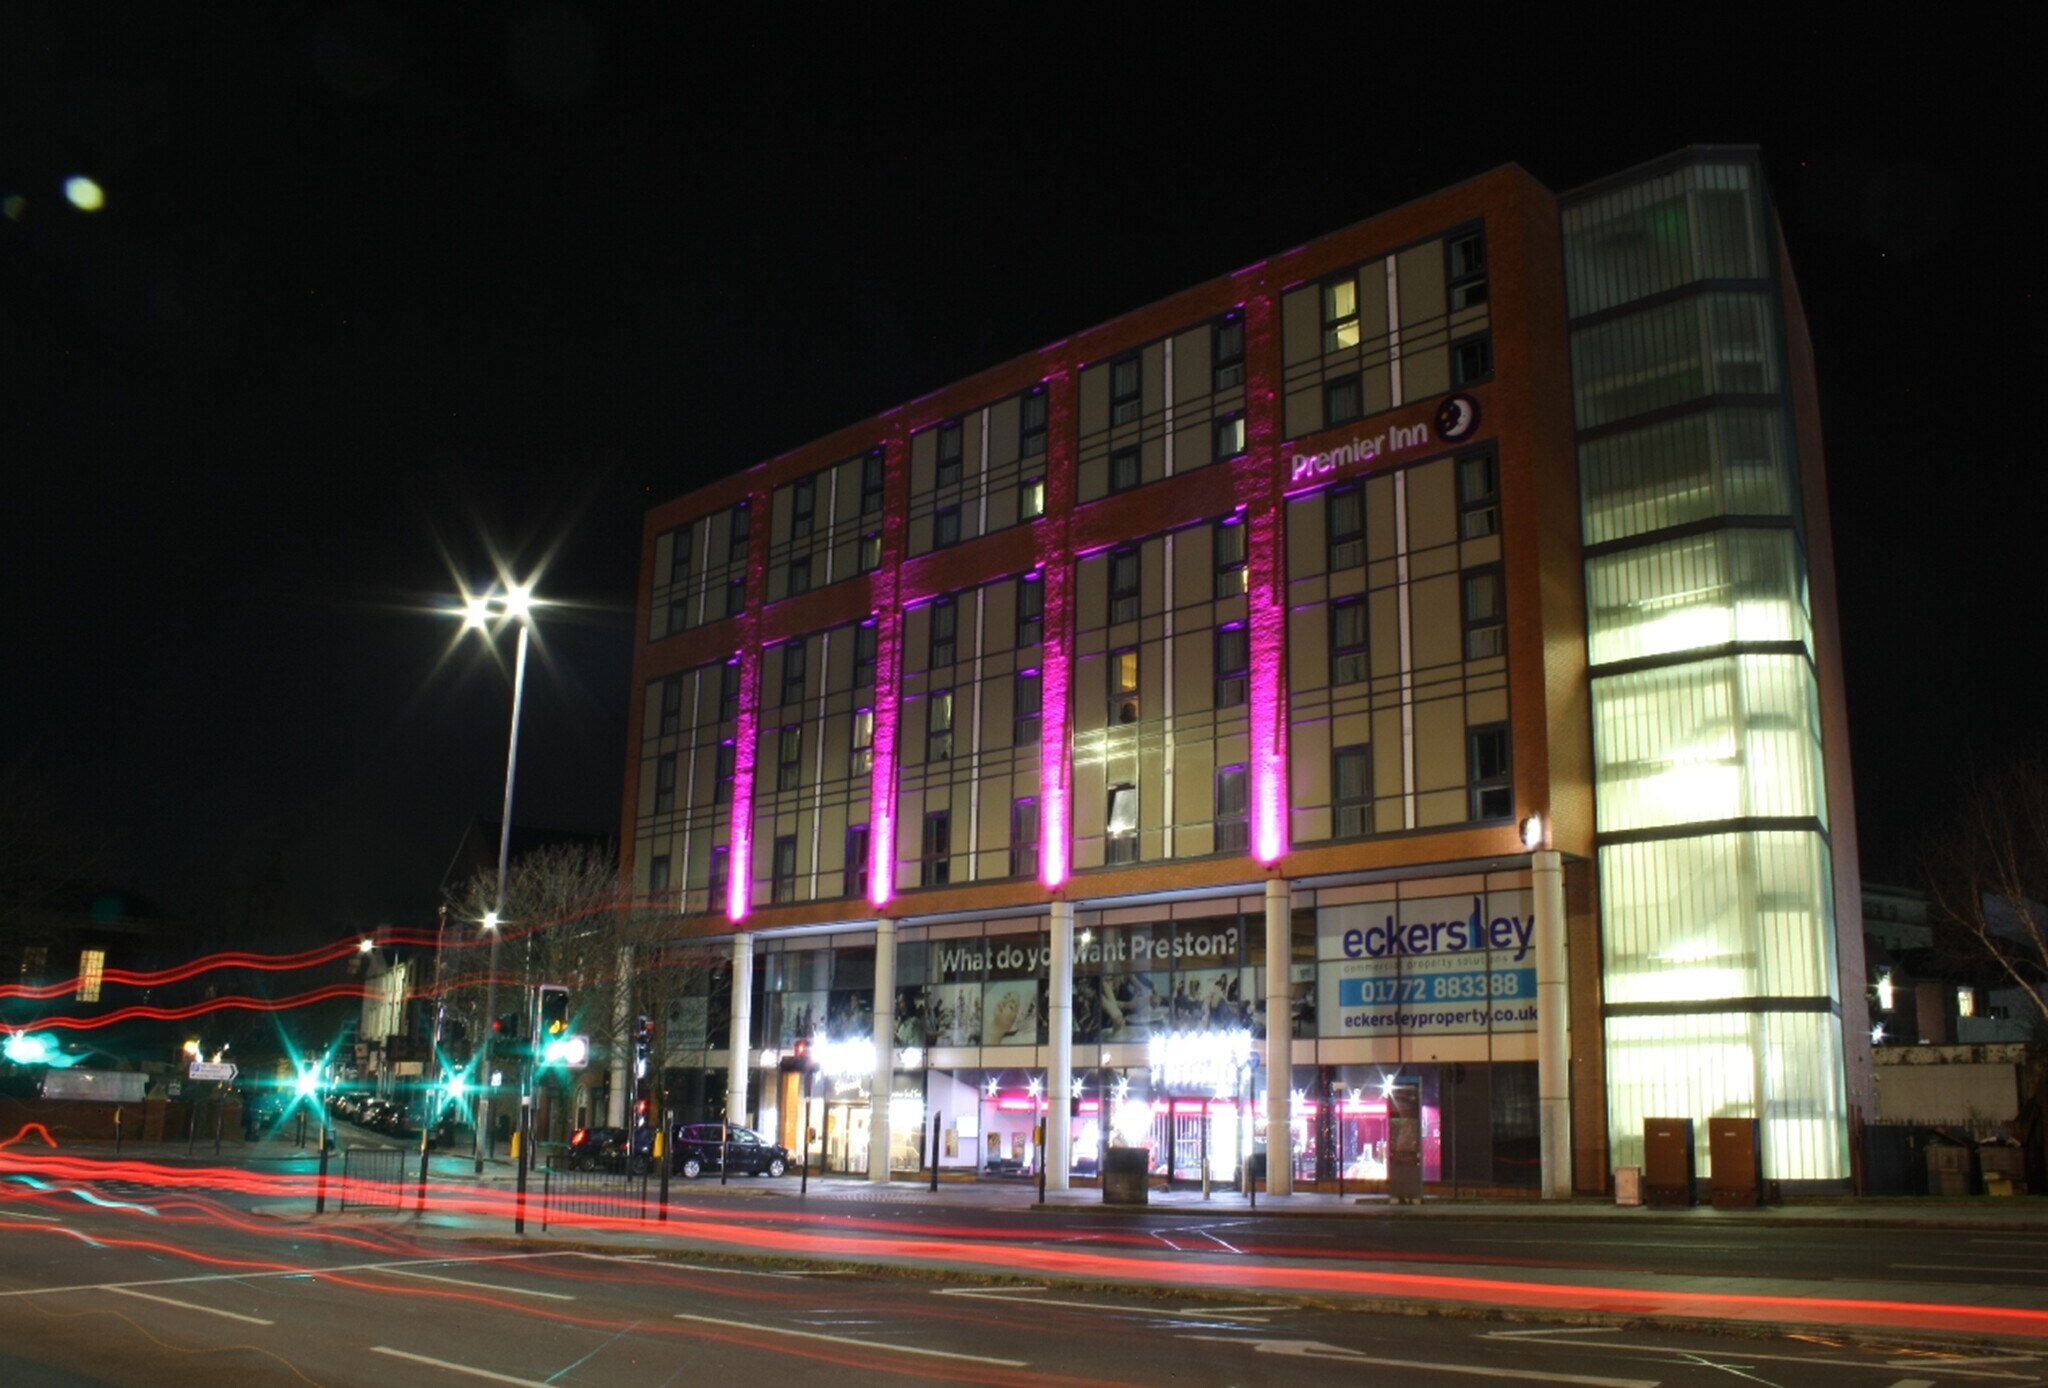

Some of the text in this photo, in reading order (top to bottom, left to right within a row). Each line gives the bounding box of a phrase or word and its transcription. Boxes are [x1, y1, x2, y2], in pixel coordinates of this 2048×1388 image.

[1291, 421, 1429, 481] Premier Inn
[939, 927, 1238, 972] What do yo want Preston?
[1343, 896, 1535, 962] eckersley
[1361, 973, 1519, 1002] 01772 883388
[1344, 1005, 1538, 1028] eckersleyproperty.co.uk
